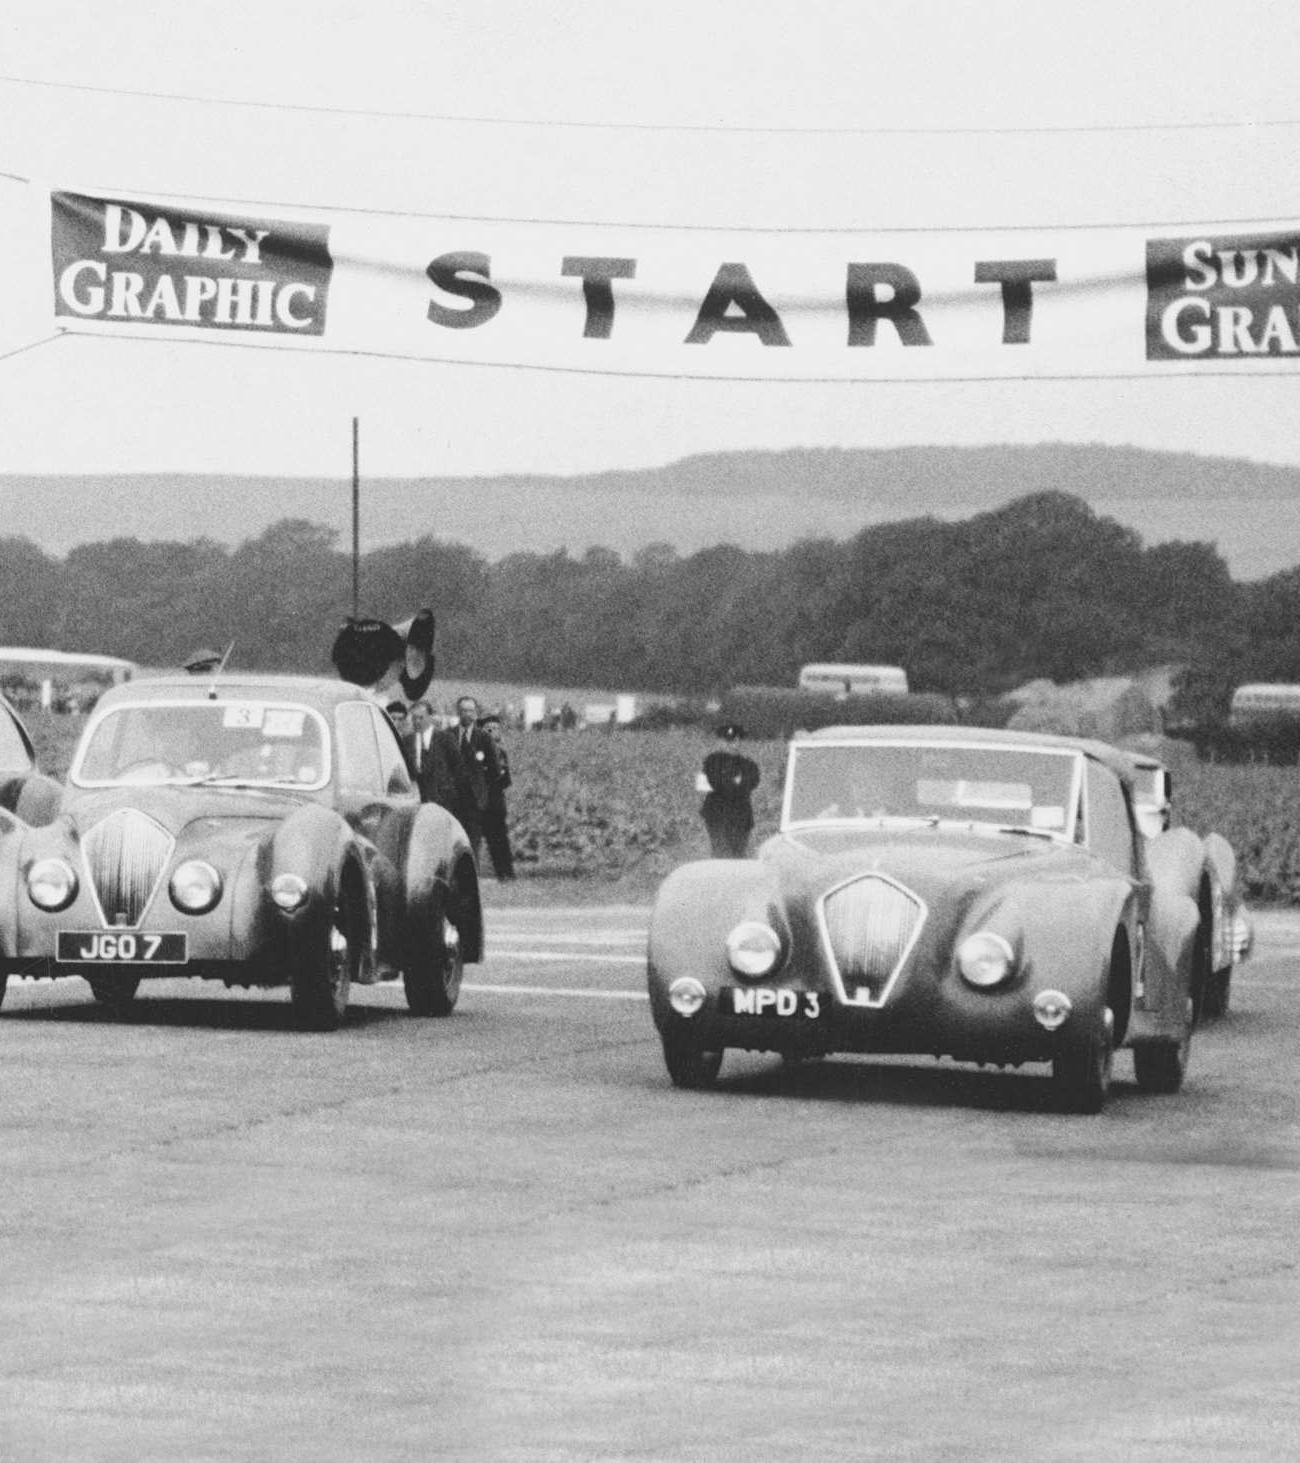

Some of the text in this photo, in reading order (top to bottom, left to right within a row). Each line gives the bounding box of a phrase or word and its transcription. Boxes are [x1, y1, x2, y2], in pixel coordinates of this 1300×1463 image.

[101, 203, 270, 264] DAILY
[59, 259, 316, 328] GRAPHIC
[1182, 240, 1300, 291] SUN
[425, 250, 1057, 347] START
[1161, 296, 1300, 354] GRA
[79, 933, 163, 960] JGO 7
[733, 988, 820, 1019] MPD 3
